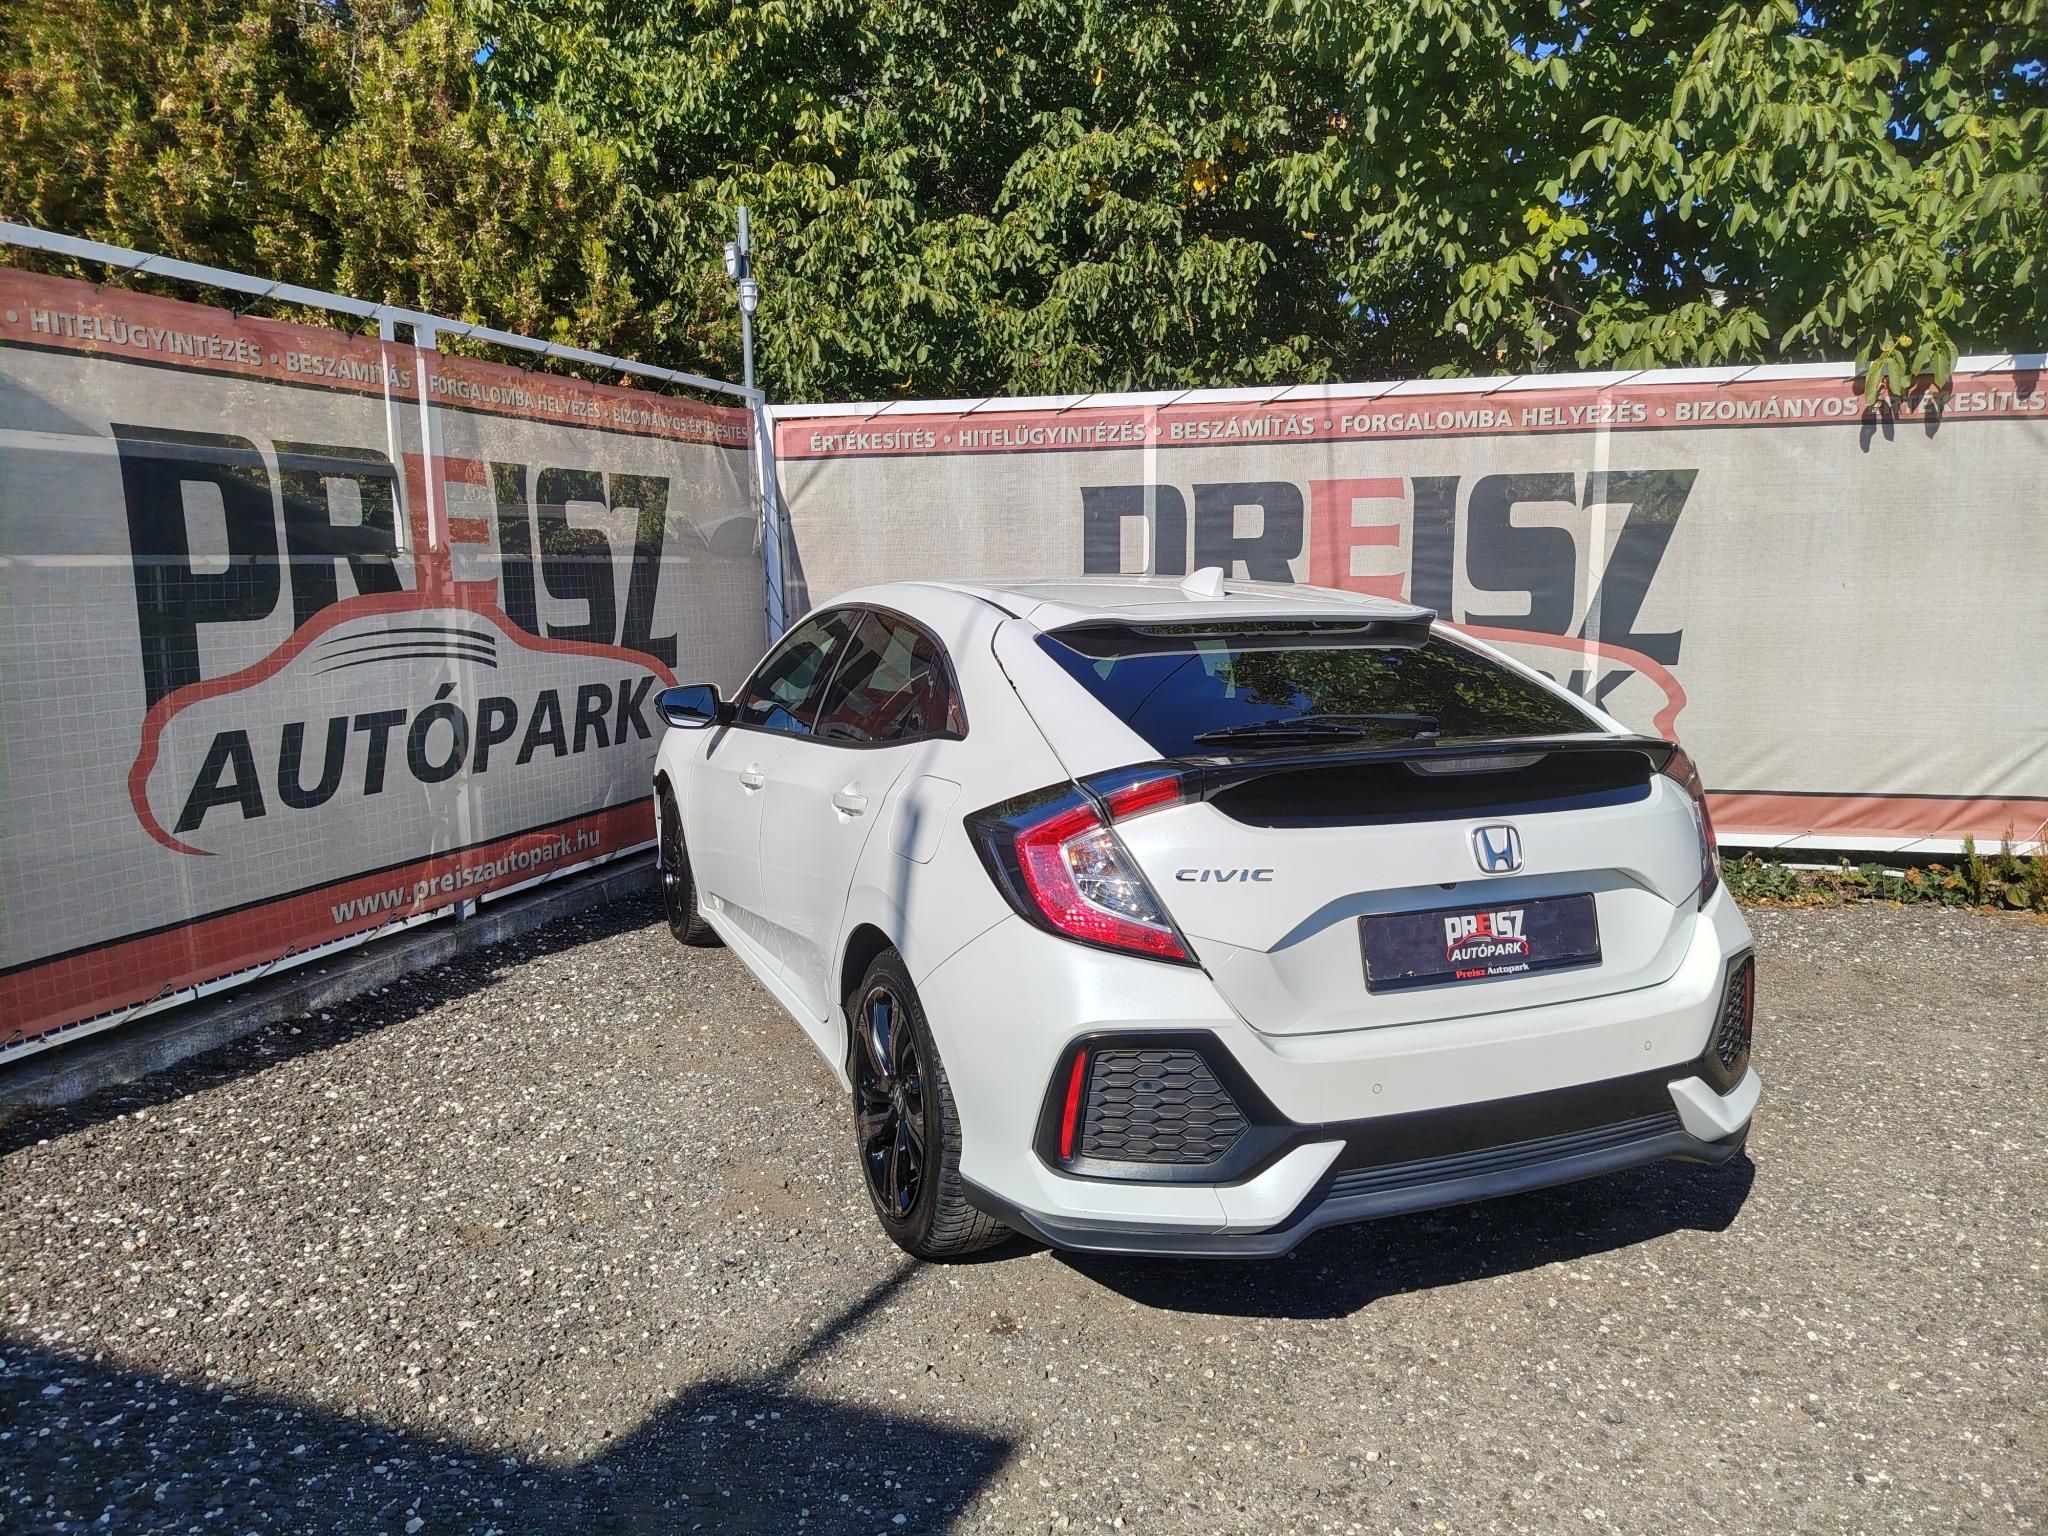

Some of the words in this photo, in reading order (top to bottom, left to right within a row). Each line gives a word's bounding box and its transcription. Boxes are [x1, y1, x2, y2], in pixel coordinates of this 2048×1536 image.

[30, 307, 263, 367] HITELÜGYINTÉZÉS
[286, 351, 412, 389] BESZÁMÍTÁS
[428, 375, 534, 409] FORGALOMBA
[537, 394, 601, 419] HELYEZÉS
[809, 427, 937, 453] ÉRTÉKESÍTÉS
[959, 420, 1147, 448] HITELÜGYINTÉZÉS
[1170, 413, 1315, 441] BESZÁMÍTÁS
[1340, 409, 1514, 434] FORGALOMBA
[1521, 400, 1648, 427] HELYEZÉS
[1675, 395, 1859, 422] BIZOMÁNYOS
[110, 422, 678, 713] PREISZ
[173, 675, 655, 834] AUTÓPARK
[330, 828, 601, 925] www.preiszautopark.hu
[1175, 868, 1275, 883] CIVIC
[1444, 909, 1527, 948] PREISZ
[1451, 942, 1522, 962] AUTÓPARK
[1456, 968, 1487, 979] Preisz
[1487, 962, 1530, 976] Autopark
